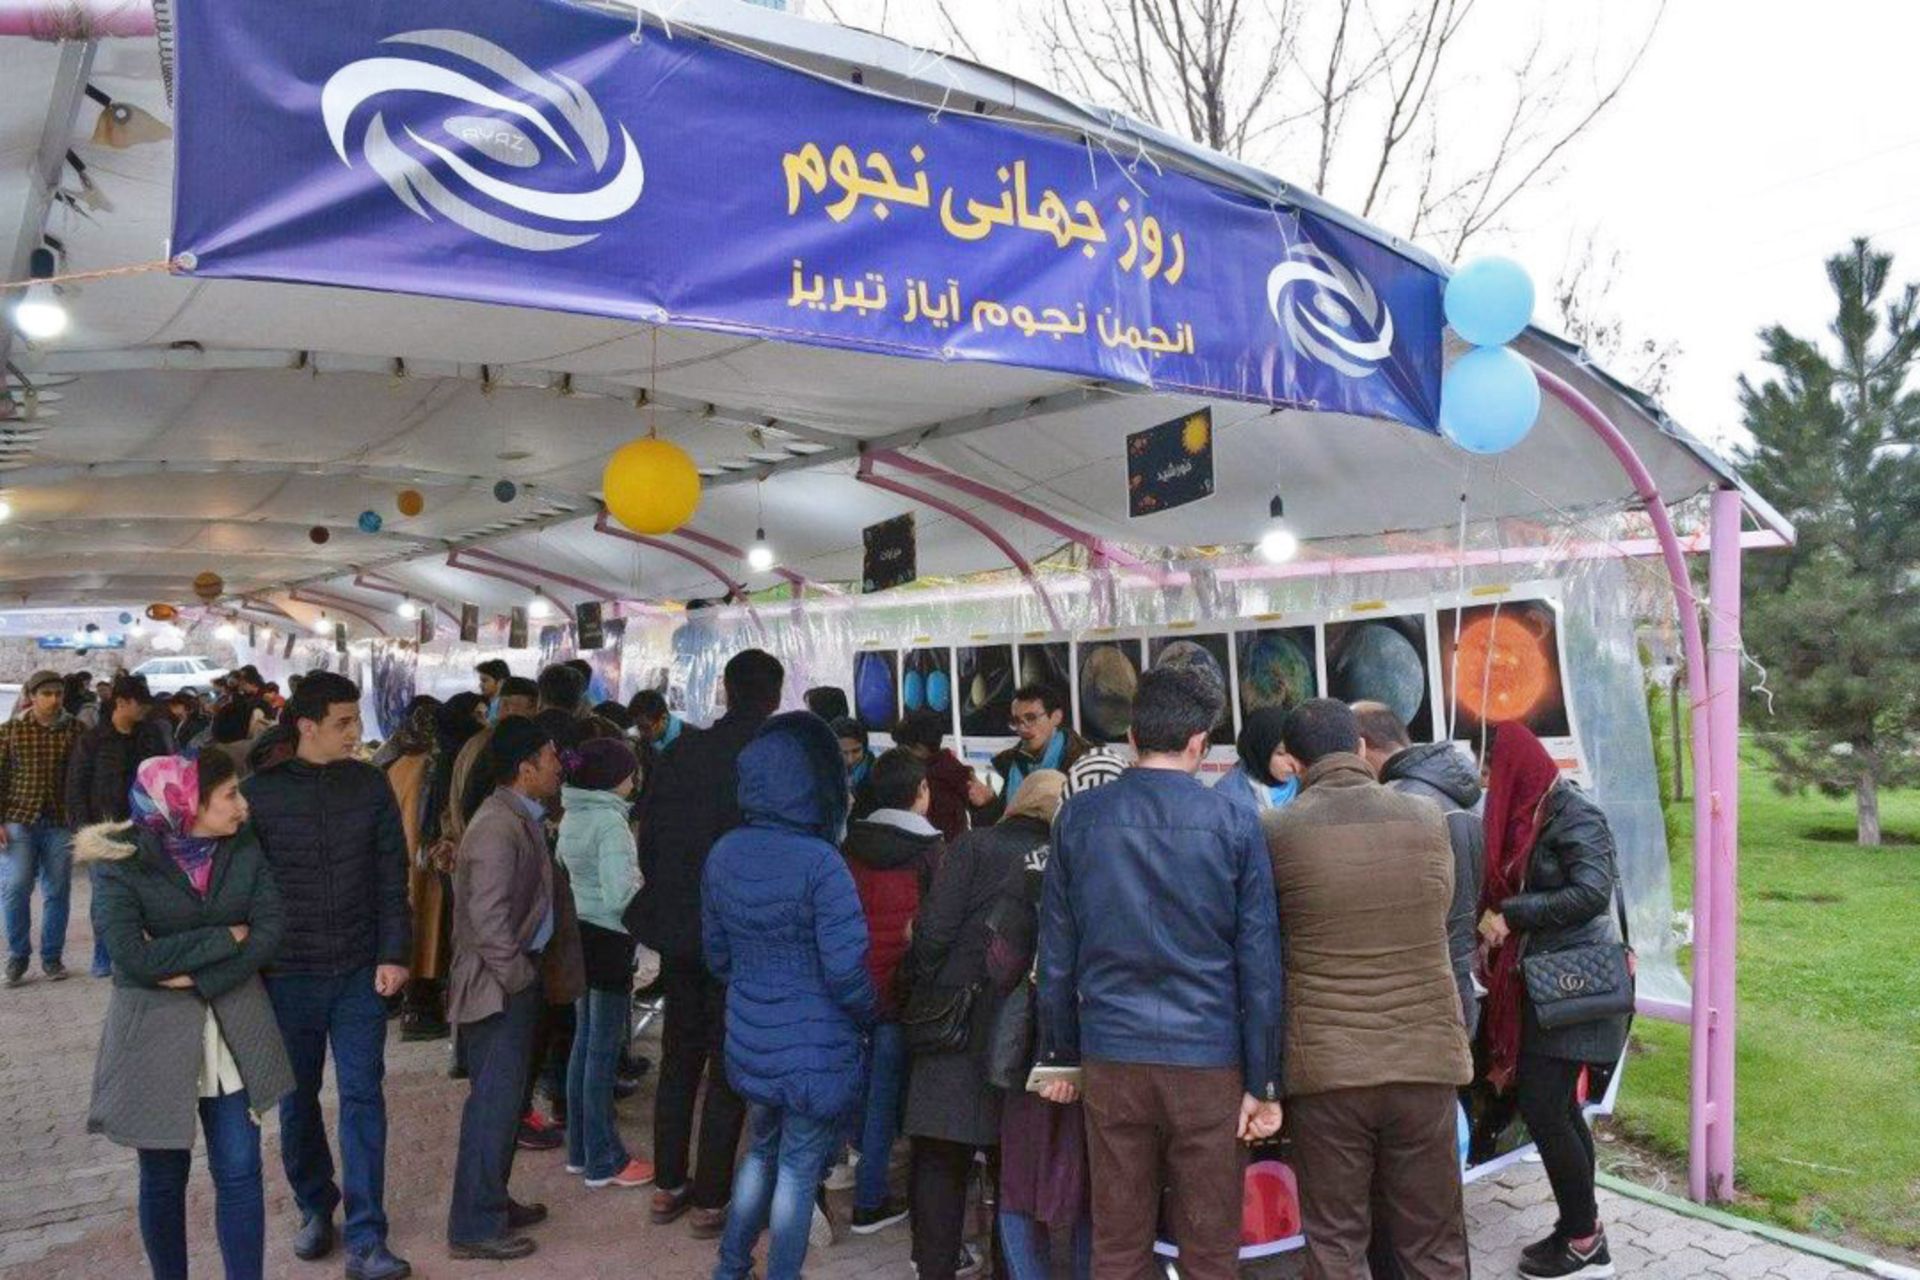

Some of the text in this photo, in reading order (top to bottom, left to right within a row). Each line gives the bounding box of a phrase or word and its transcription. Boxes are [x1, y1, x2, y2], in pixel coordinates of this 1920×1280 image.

[782, 142, 1185, 285] روز جهانی نجوم
[787, 259, 1195, 358] انجمن نجوم آیاز تبریز
